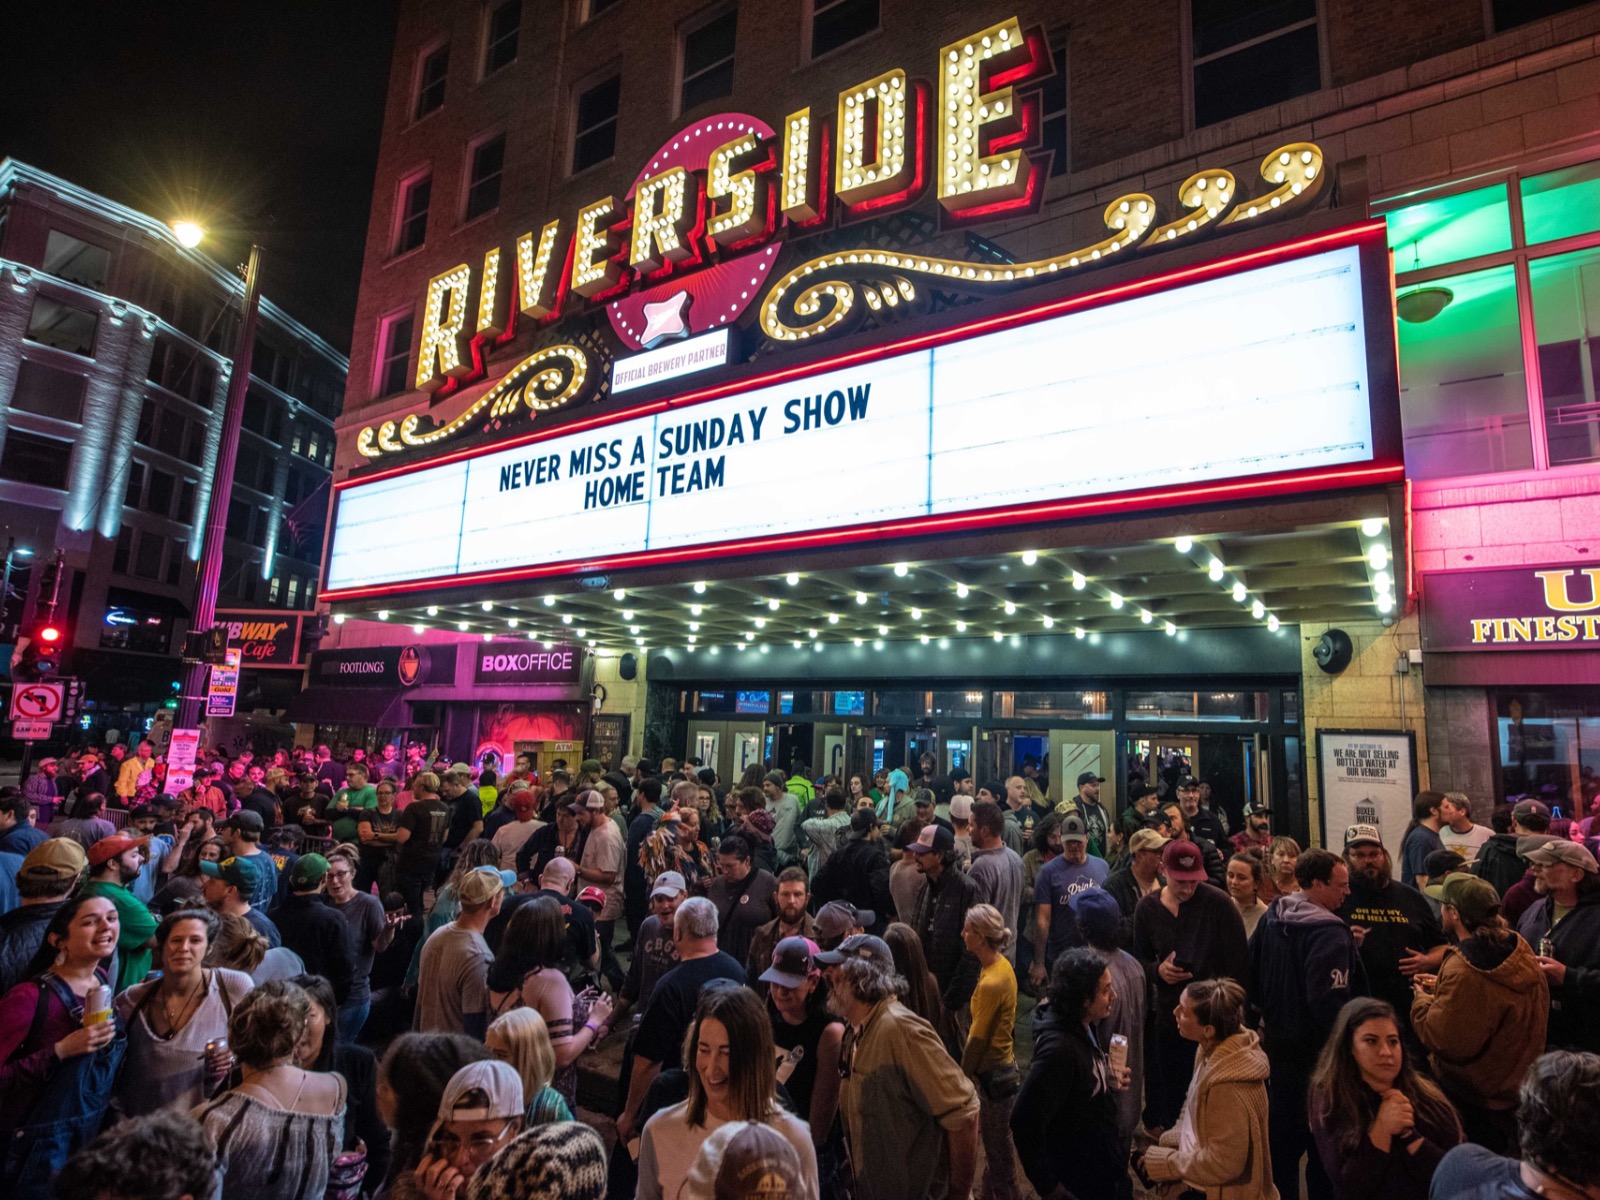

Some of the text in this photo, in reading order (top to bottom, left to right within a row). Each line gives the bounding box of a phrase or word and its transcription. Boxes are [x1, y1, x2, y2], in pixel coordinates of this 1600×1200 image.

[415, 16, 1031, 391] RIVERSIDE
[614, 343, 726, 385] OFFICIAL BREWERY PARTNER
[499, 383, 871, 492] NEVER MISS A SUNDAY SHOW
[584, 455, 726, 510] HOME TEAM
[212, 622, 288, 640] BWAY
[1470, 615, 1600, 643] FINEST
[242, 641, 276, 660] Cafe
[339, 661, 384, 674] FOOTLONGS
[555, 744, 573, 752] ATM
[1334, 749, 1399, 760] WE ARE NOT SELLING
[1336, 758, 1396, 769] BOTTLED WATER AT
[1346, 767, 1359, 776] OUR
[1356, 807, 1375, 815] BOXED
[1067, 878, 1095, 896] Drink
[1367, 915, 1389, 923] HELL
[1371, 908, 1385, 916] MY
